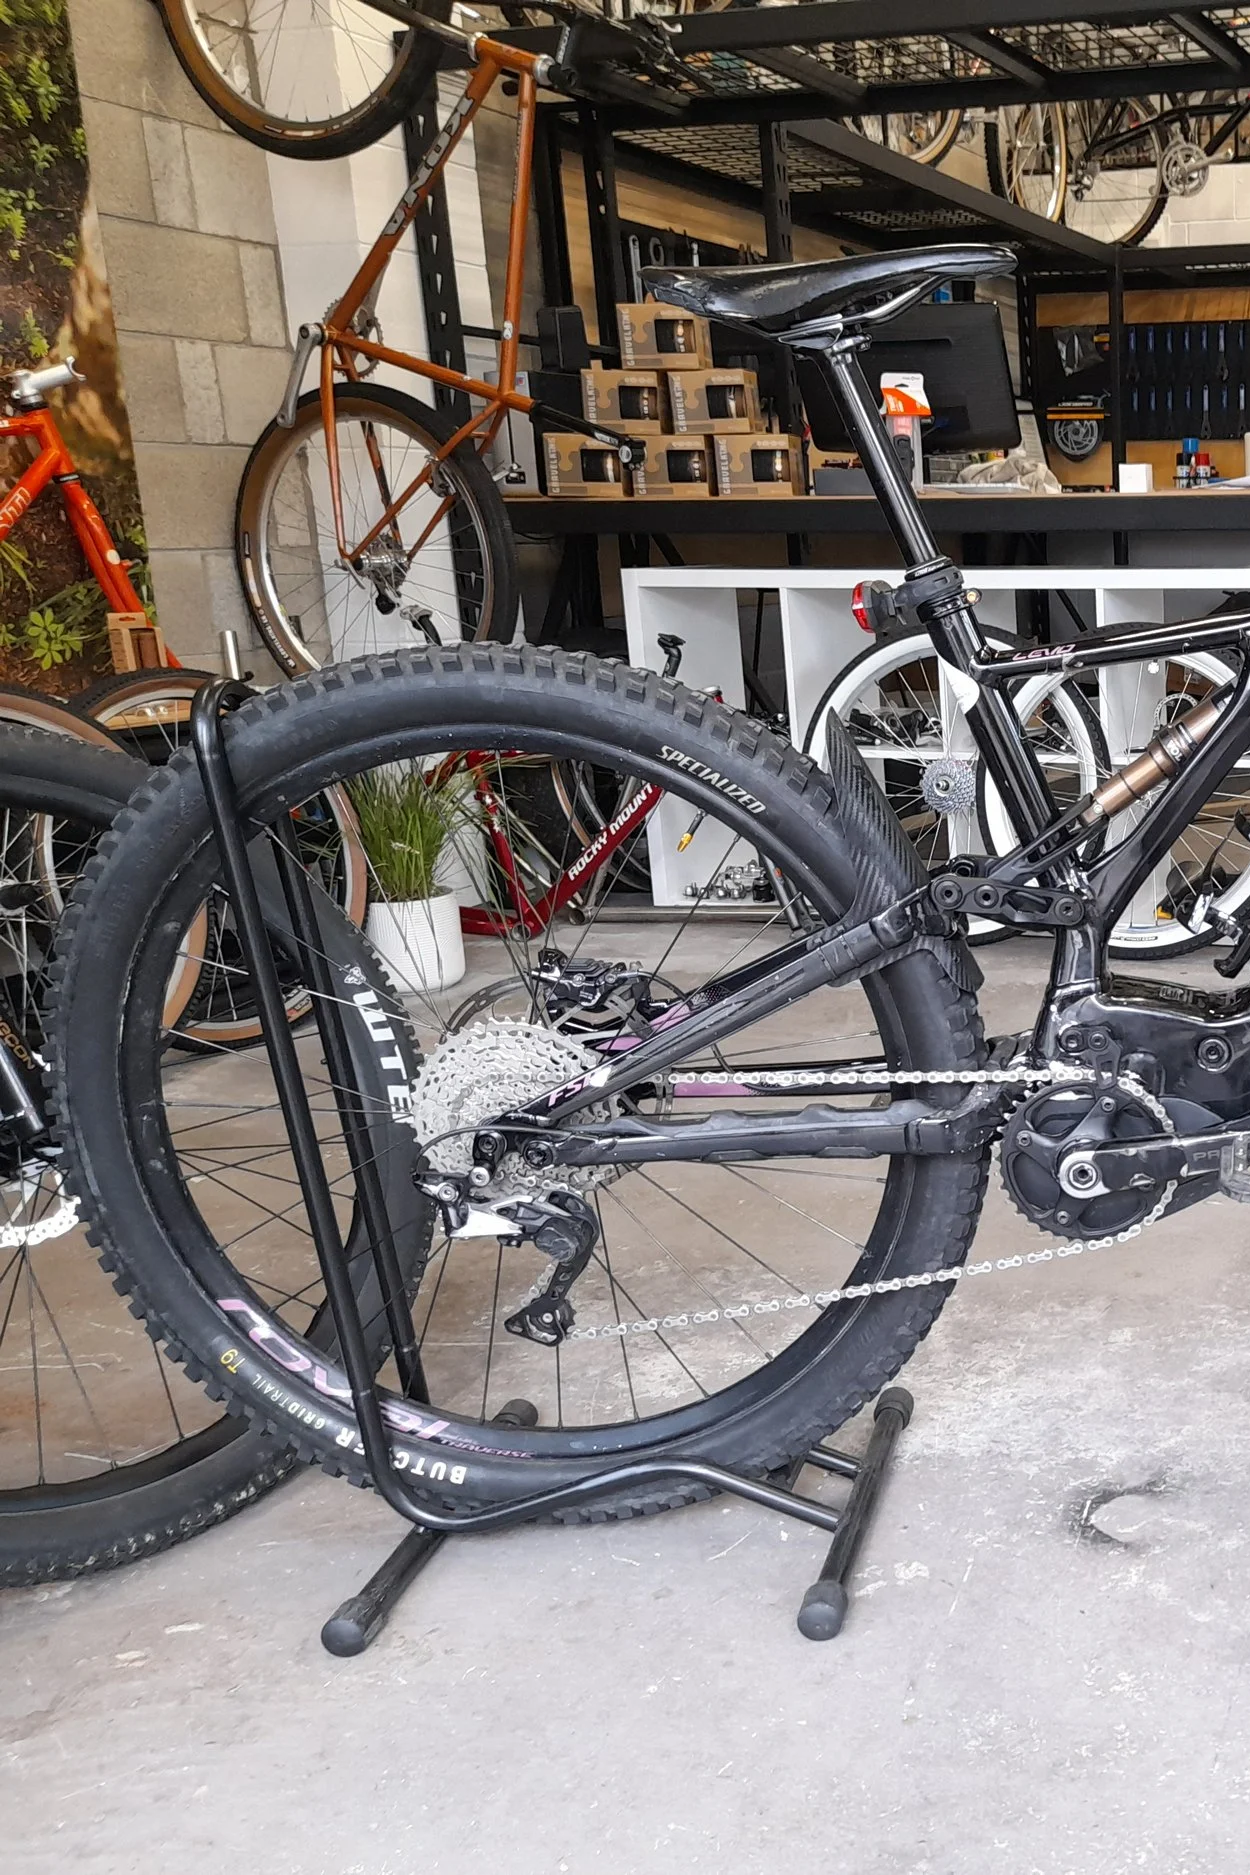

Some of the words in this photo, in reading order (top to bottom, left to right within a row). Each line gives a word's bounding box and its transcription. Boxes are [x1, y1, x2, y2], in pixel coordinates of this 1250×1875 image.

[382, 96, 476, 237] KONA
[588, 374, 600, 424] RAVELKING
[1012, 643, 1077, 661] LEVO
[656, 745, 766, 814] SPECIALIZED
[567, 831, 609, 881] ROCKY
[0, 1020, 36, 1069] ECON
[220, 1348, 246, 1374] T9
[335, 1427, 468, 1485] BUTCER
